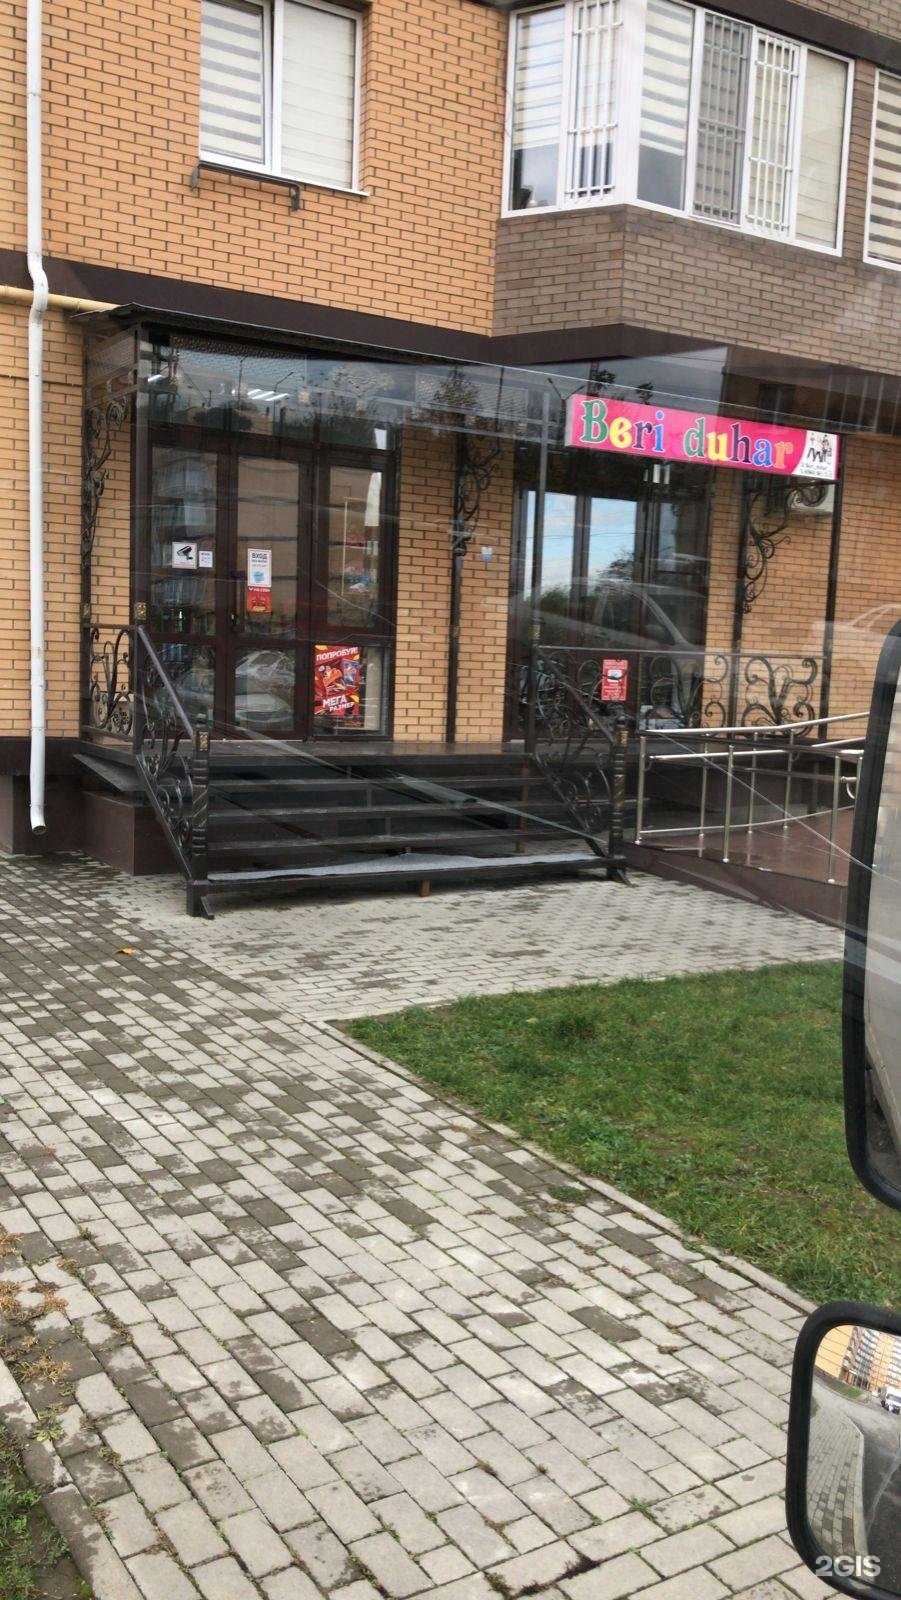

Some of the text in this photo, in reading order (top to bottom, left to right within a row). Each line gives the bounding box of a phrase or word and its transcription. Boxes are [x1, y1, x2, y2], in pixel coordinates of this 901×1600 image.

[579, 399, 794, 469] Beri duhar
[316, 646, 358, 661] ПОПРОБУЙ!
[322, 694, 348, 708] МЕГА
